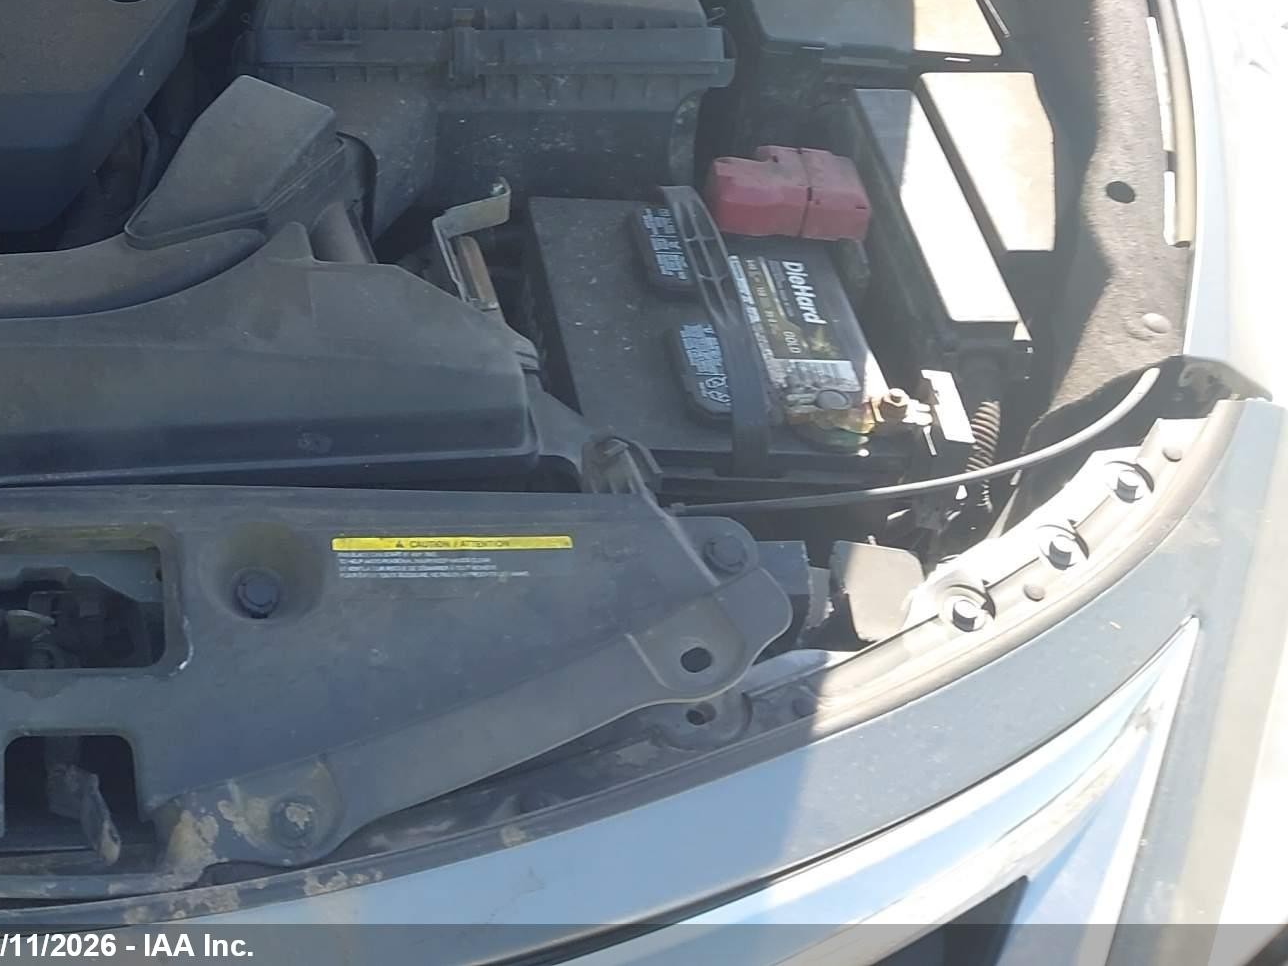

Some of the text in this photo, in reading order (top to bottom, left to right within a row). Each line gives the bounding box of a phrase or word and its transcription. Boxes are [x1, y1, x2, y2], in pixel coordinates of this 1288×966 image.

[782, 260, 827, 325] DieHard
[783, 330, 802, 354] GOLD
[409, 540, 451, 548] CAUTION
[460, 539, 511, 548] ATTENTION
